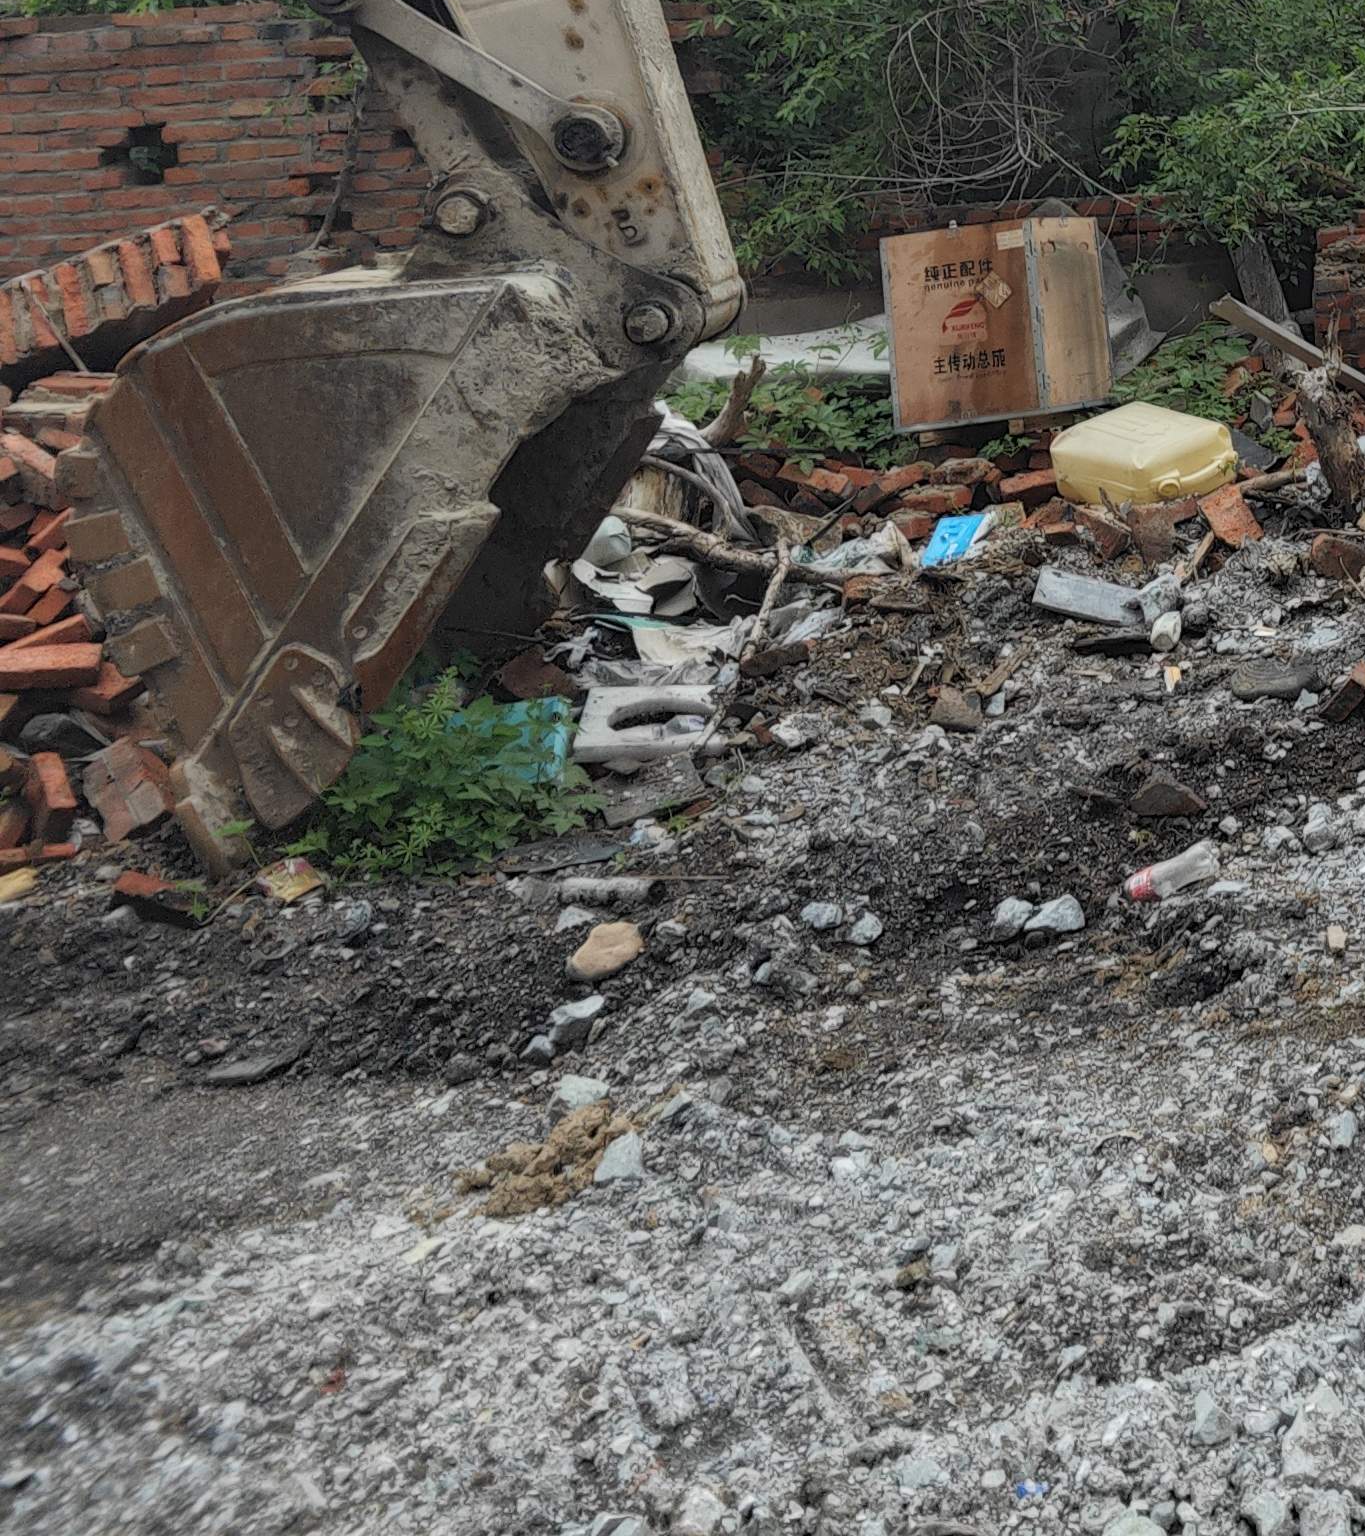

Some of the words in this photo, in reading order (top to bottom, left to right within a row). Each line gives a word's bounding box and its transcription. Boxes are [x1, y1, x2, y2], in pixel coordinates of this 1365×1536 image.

[933, 348, 1007, 375] 主传动总成
